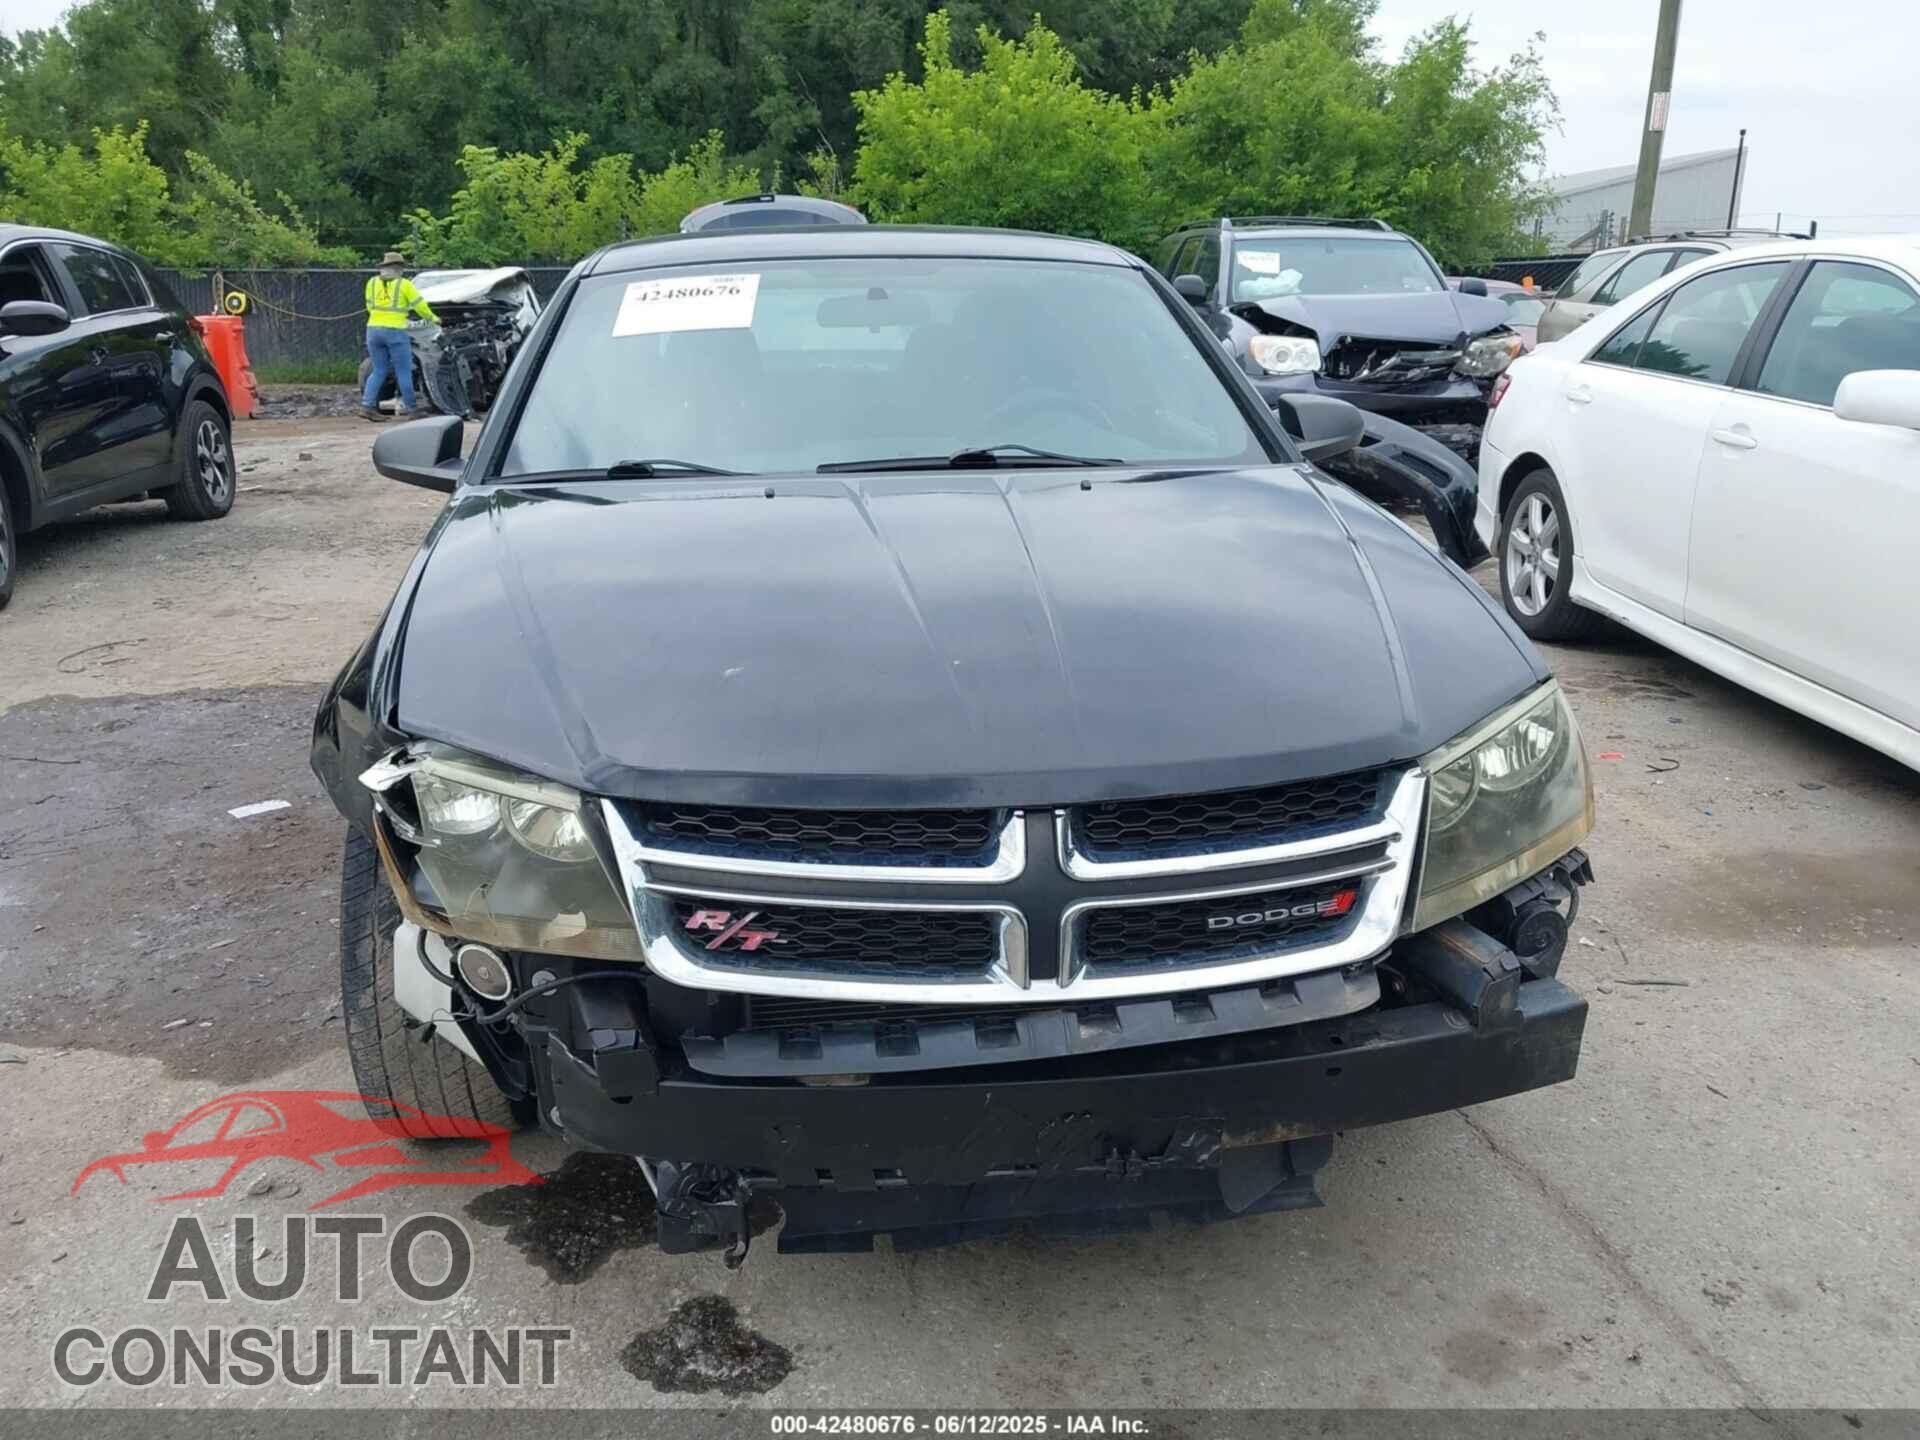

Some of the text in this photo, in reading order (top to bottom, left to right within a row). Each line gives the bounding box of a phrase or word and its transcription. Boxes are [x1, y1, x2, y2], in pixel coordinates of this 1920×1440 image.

[636, 285, 741, 302] 42480676
[1207, 898, 1338, 929] DODGE
[684, 908, 780, 951] R/T
